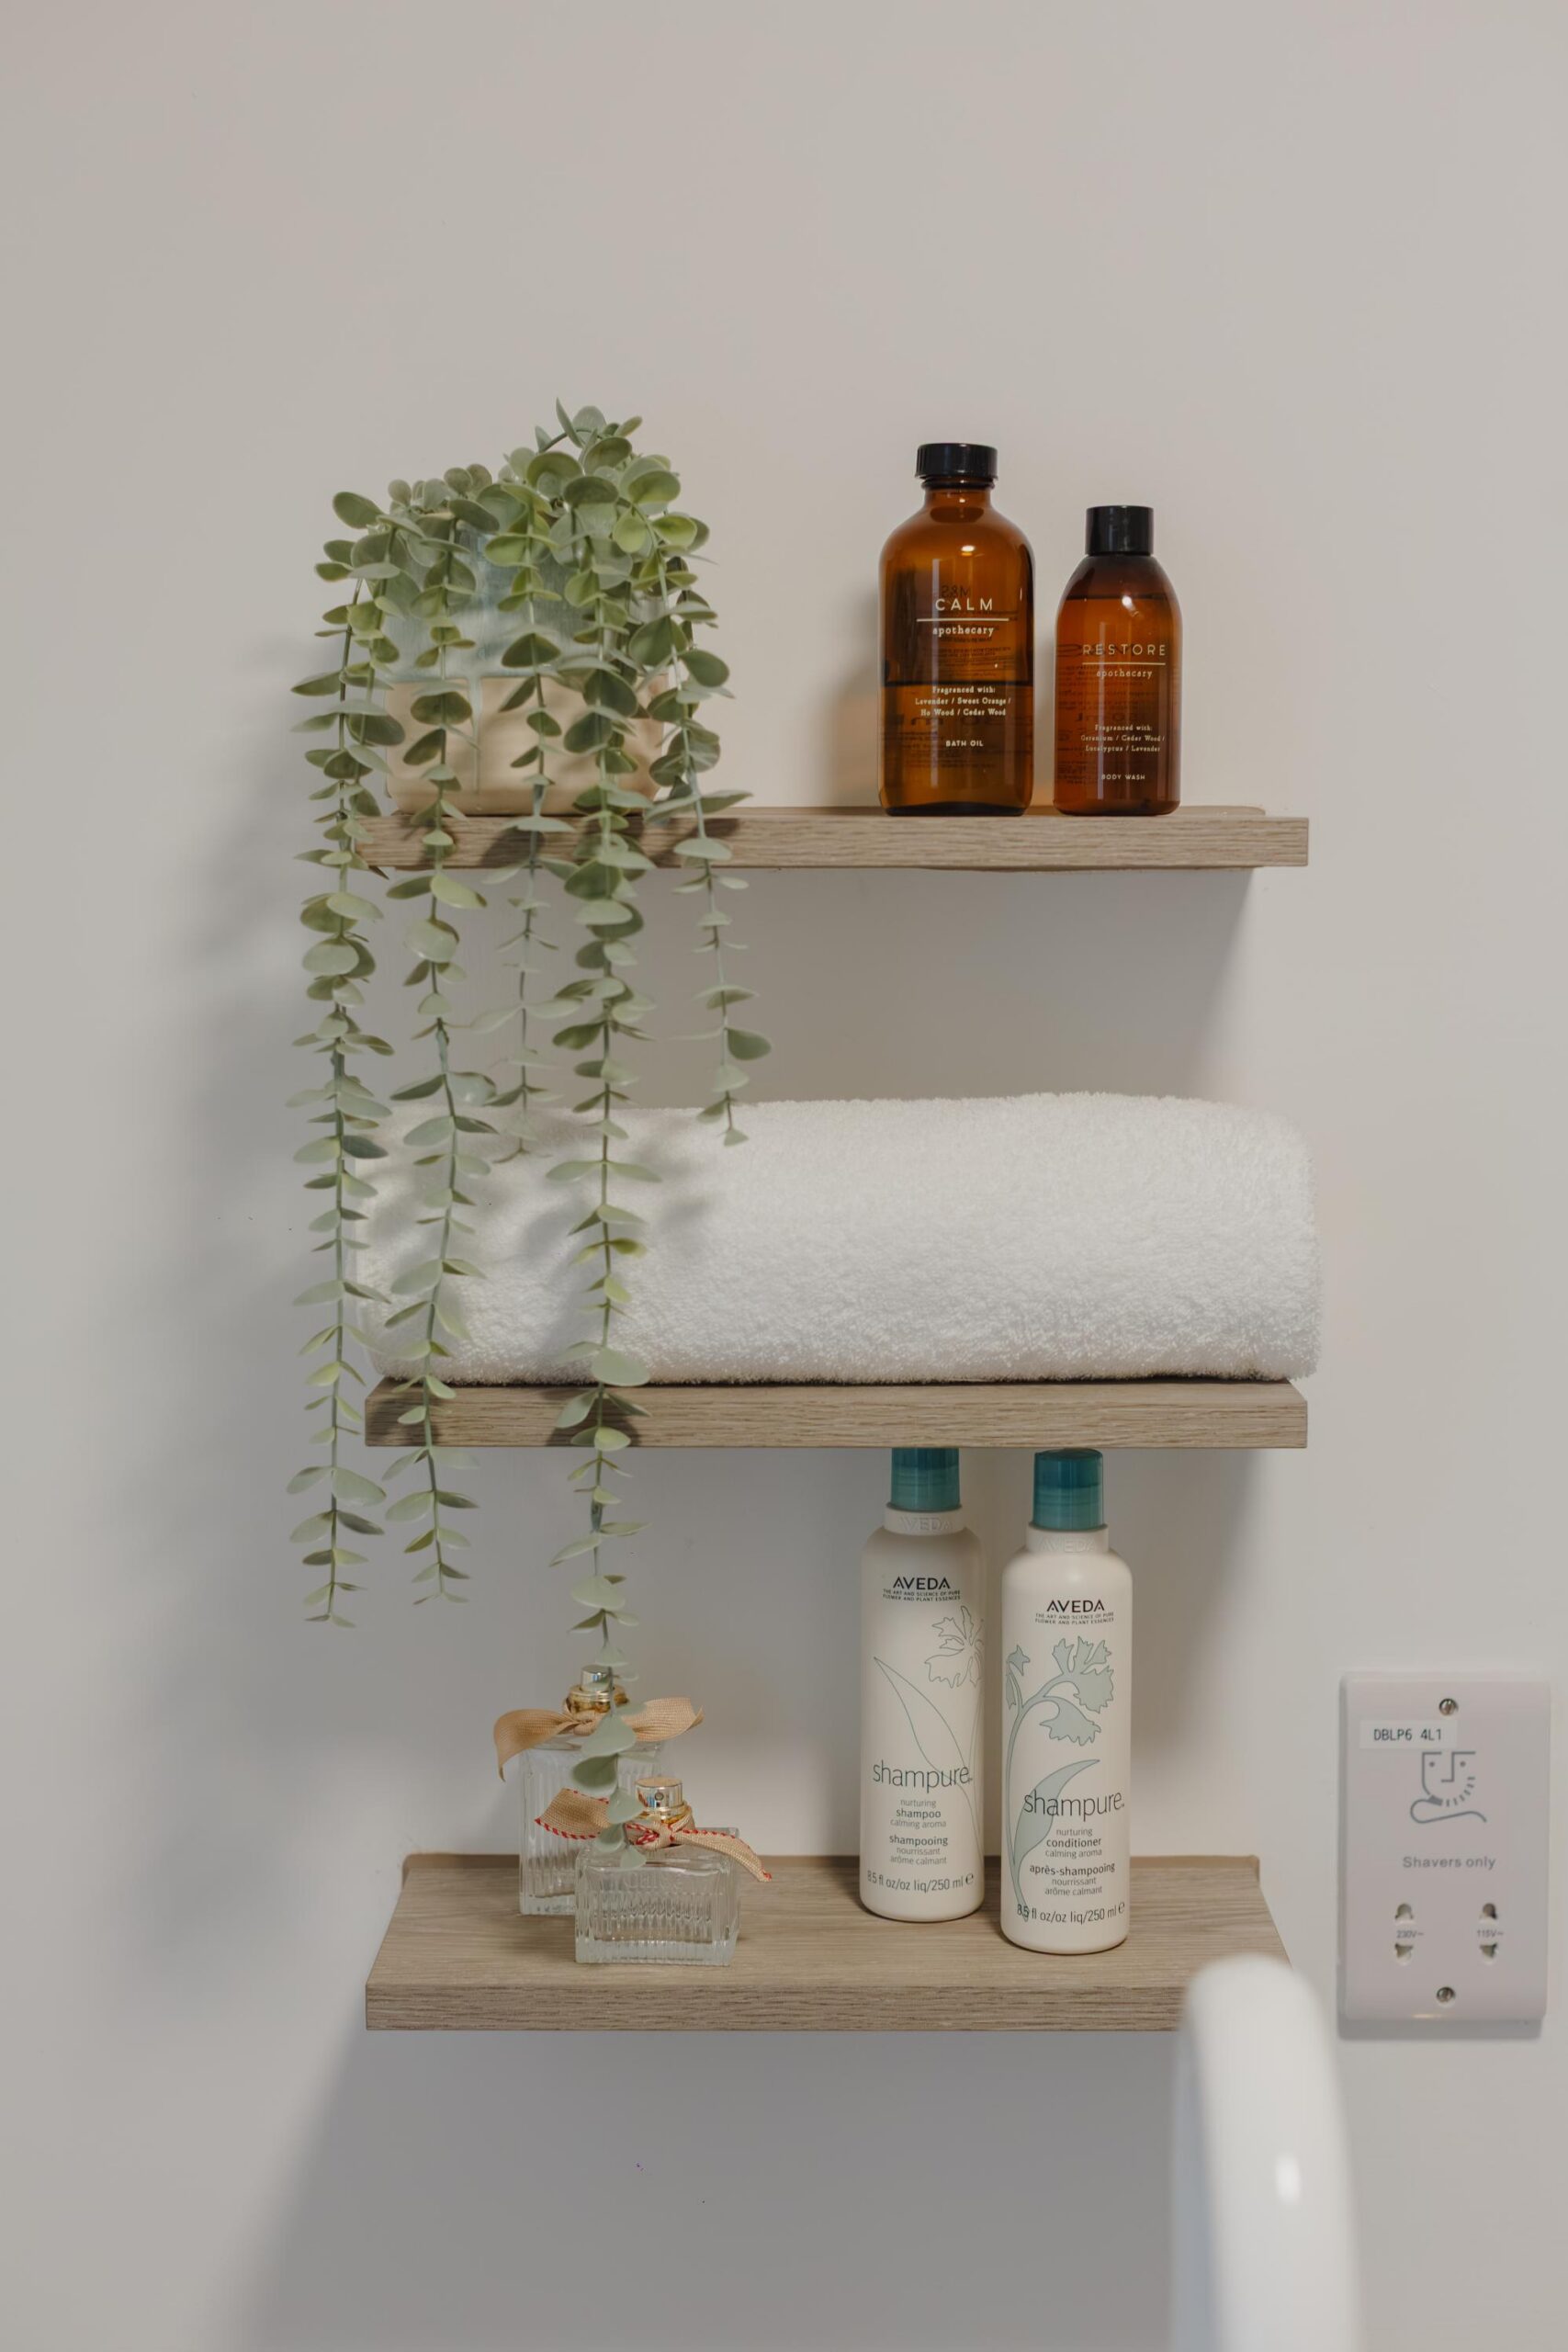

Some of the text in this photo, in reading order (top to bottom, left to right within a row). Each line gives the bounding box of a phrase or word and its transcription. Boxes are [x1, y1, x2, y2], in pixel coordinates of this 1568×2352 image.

[935, 598, 993, 611] CALM
[932, 624, 995, 637] apothecary
[1082, 644, 1166, 655] RESTORE
[1096, 669, 1153, 680] apothecary
[932, 685, 975, 695] Fragranced
[915, 697, 949, 706] Lavender
[957, 697, 980, 706] Sweet
[982, 697, 1007, 707] Orange
[1094, 724, 1134, 732] Fragranced
[893, 1576, 951, 1590] AVEDA
[1046, 1599, 1105, 1612] AVEDA
[1373, 1728, 1442, 1741] DBLP6 4L1
[873, 1758, 970, 1793] shampure
[900, 1799, 936, 1808] nurturing
[1023, 1788, 1124, 1822] shampure
[896, 1808, 942, 1820] shampoo
[890, 1819, 946, 1829] calming aroma
[1056, 1828, 1093, 1837] nurturing
[889, 1835, 948, 1847] shampooing
[1046, 1838, 1101, 1848] conditioner
[897, 1847, 941, 1856] nourrissant
[1045, 1849, 1102, 1859] calming aroma
[890, 1855, 947, 1865] arôme calmant
[1403, 1856, 1495, 1871] Shavers only
[1030, 1862, 1115, 1876] après-shampooing
[878, 1873, 884, 1886] fl
[886, 1878, 910, 1891] oz/oz
[914, 1878, 950, 1894] liq/250
[953, 1876, 964, 1888] ml
[1052, 1877, 1097, 1885] nourrissant
[1044, 1886, 1102, 1896] arôme calmant
[1032, 1907, 1037, 1919] fl
[1040, 1910, 1066, 1923] oz/oz
[1070, 1907, 1105, 1925] liq/250
[1107, 1905, 1117, 1918] ml
